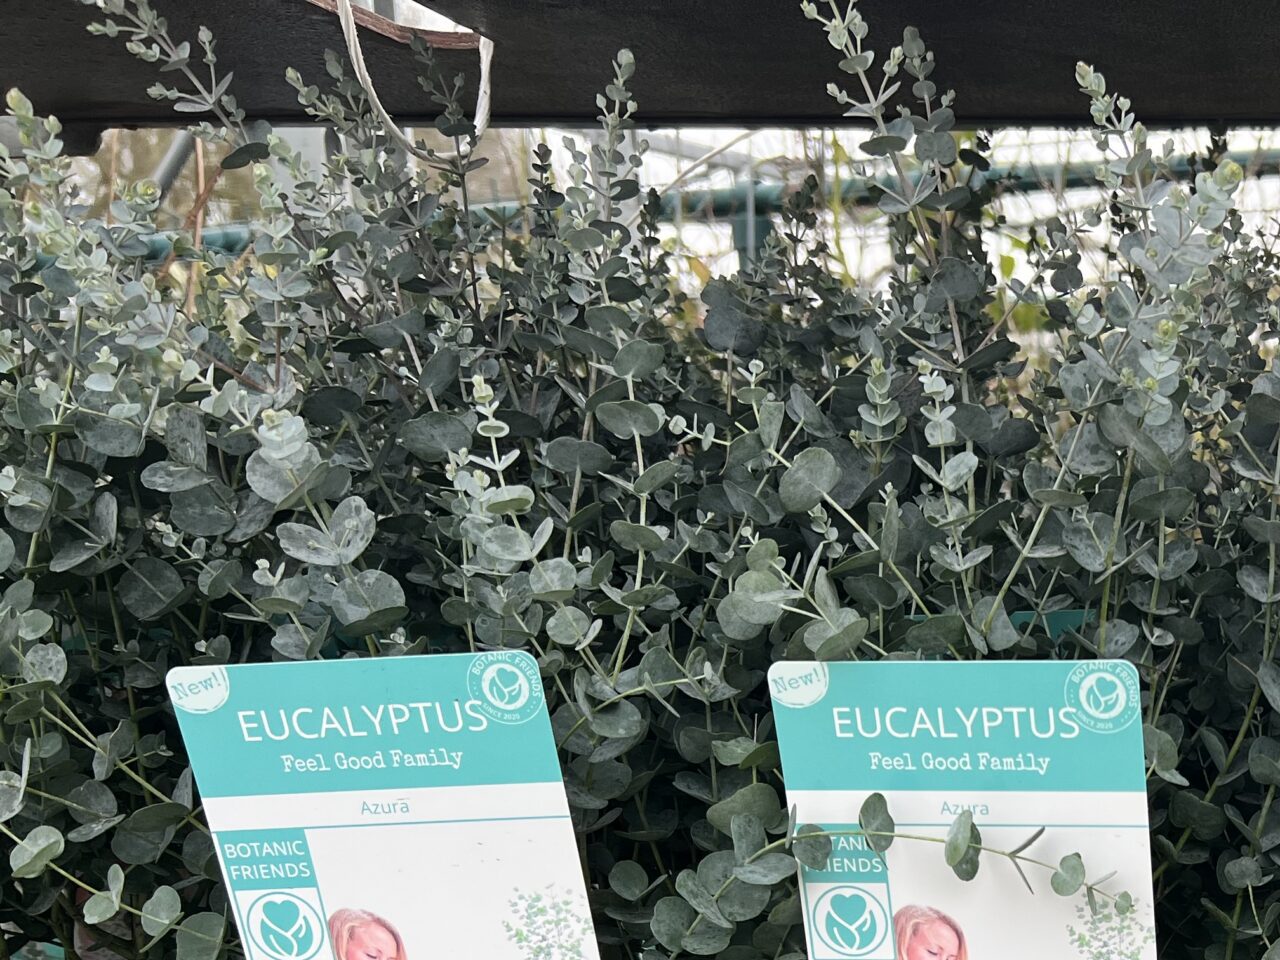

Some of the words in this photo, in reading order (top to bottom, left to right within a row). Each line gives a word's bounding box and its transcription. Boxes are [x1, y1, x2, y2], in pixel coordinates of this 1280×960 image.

[170, 672, 221, 701] New!
[471, 652, 512, 675] BOTANIC
[514, 657, 541, 697] FRIENDS
[771, 668, 821, 694] New!
[1071, 662, 1114, 683] BOTANIC
[1115, 667, 1138, 708] FRIENDS
[237, 700, 488, 742] EUCALYPTUS
[832, 707, 1079, 739] EUCALYPTUS
[280, 753, 331, 773] Feel
[334, 751, 386, 771] Good
[391, 748, 464, 769] Family
[869, 752, 917, 770] Feel
[921, 752, 971, 770] Good
[977, 752, 1050, 775] Family
[360, 800, 410, 815] Azura
[224, 840, 305, 859] BOTANIC
[230, 862, 311, 880] FRIENDS
[805, 858, 882, 873] IENDS
